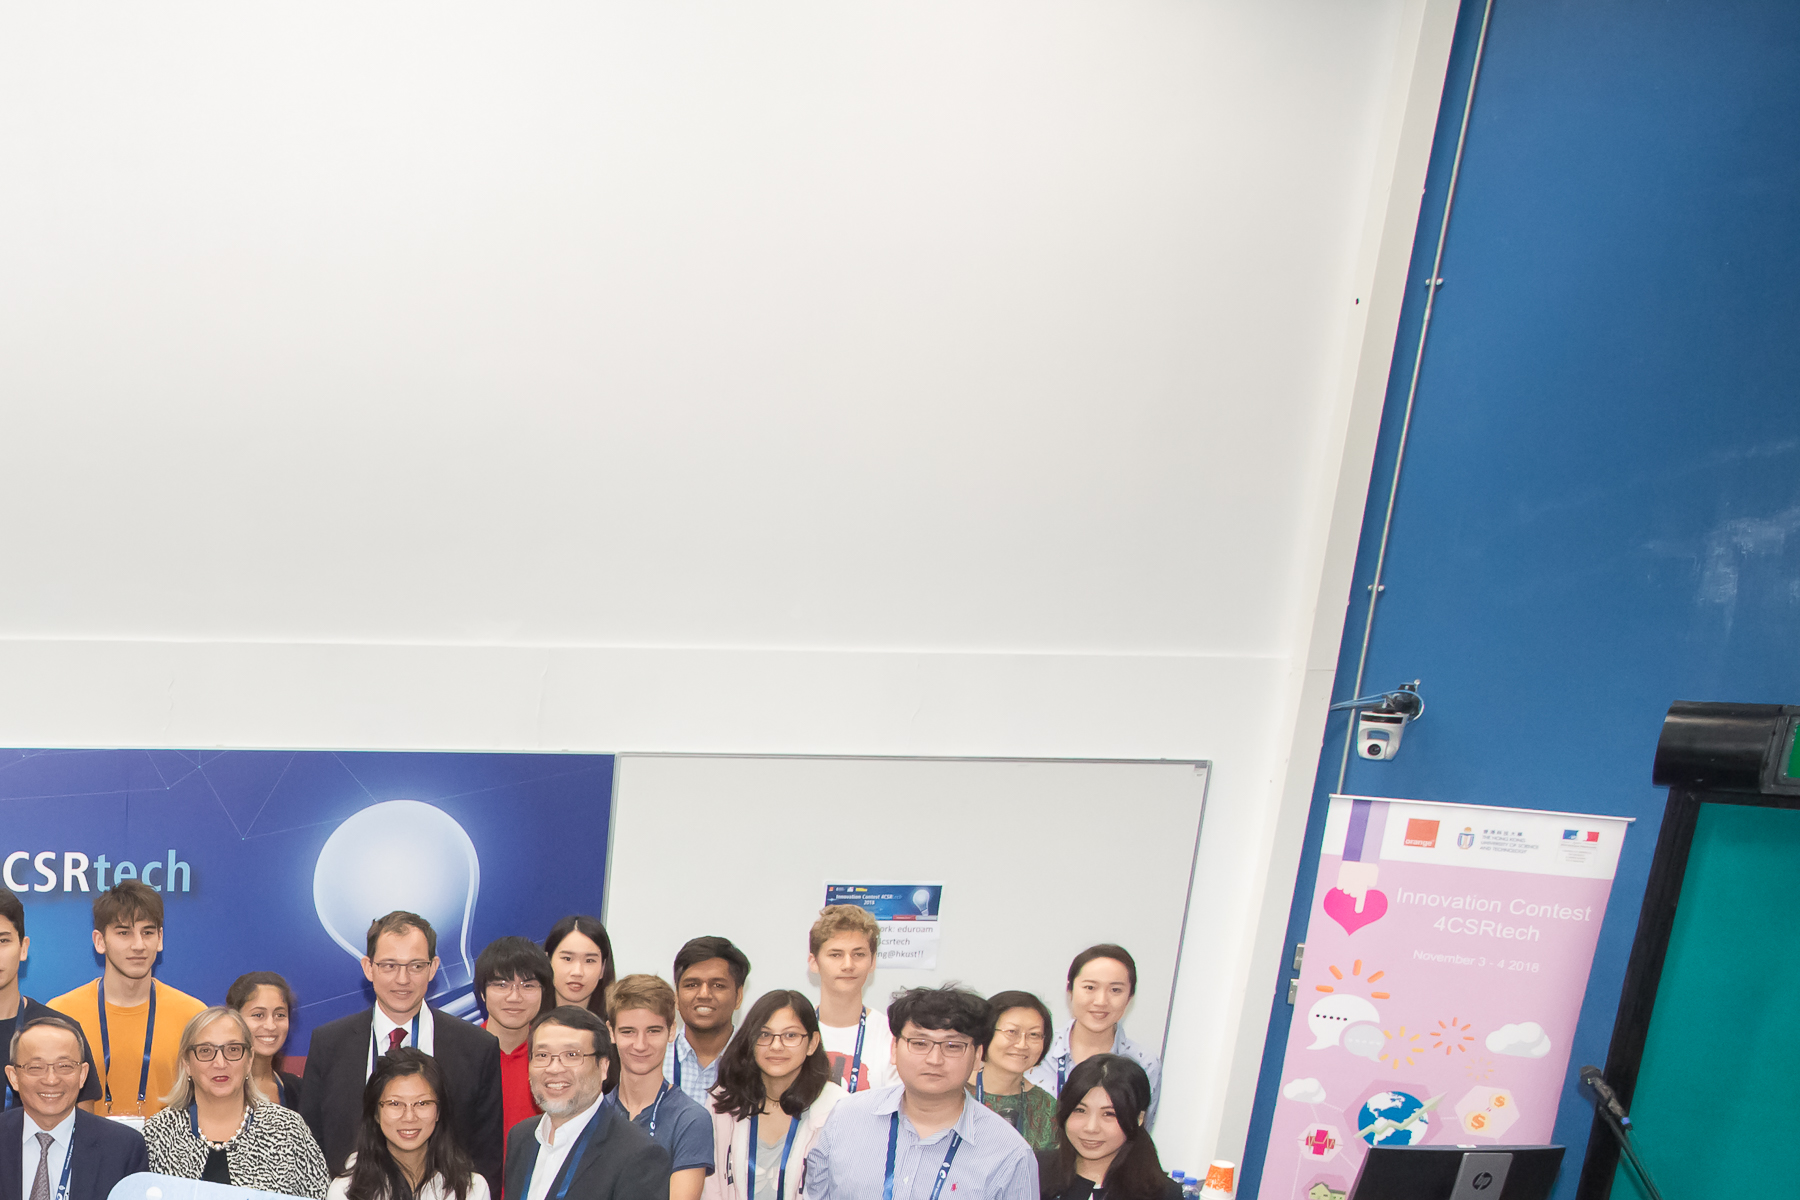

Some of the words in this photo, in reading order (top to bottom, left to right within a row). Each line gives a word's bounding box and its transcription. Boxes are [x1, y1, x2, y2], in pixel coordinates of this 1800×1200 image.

[1396, 887, 1501, 913] Innovation
[1509, 898, 1592, 922] Contest
[897, 925, 934, 933] eduroam
[1433, 916, 1540, 942] 4CSRtech
[1413, 949, 1476, 966] November
[1478, 957, 1486, 967] 3
[1496, 959, 1505, 968] 4
[1508, 960, 1540, 973] 2018
